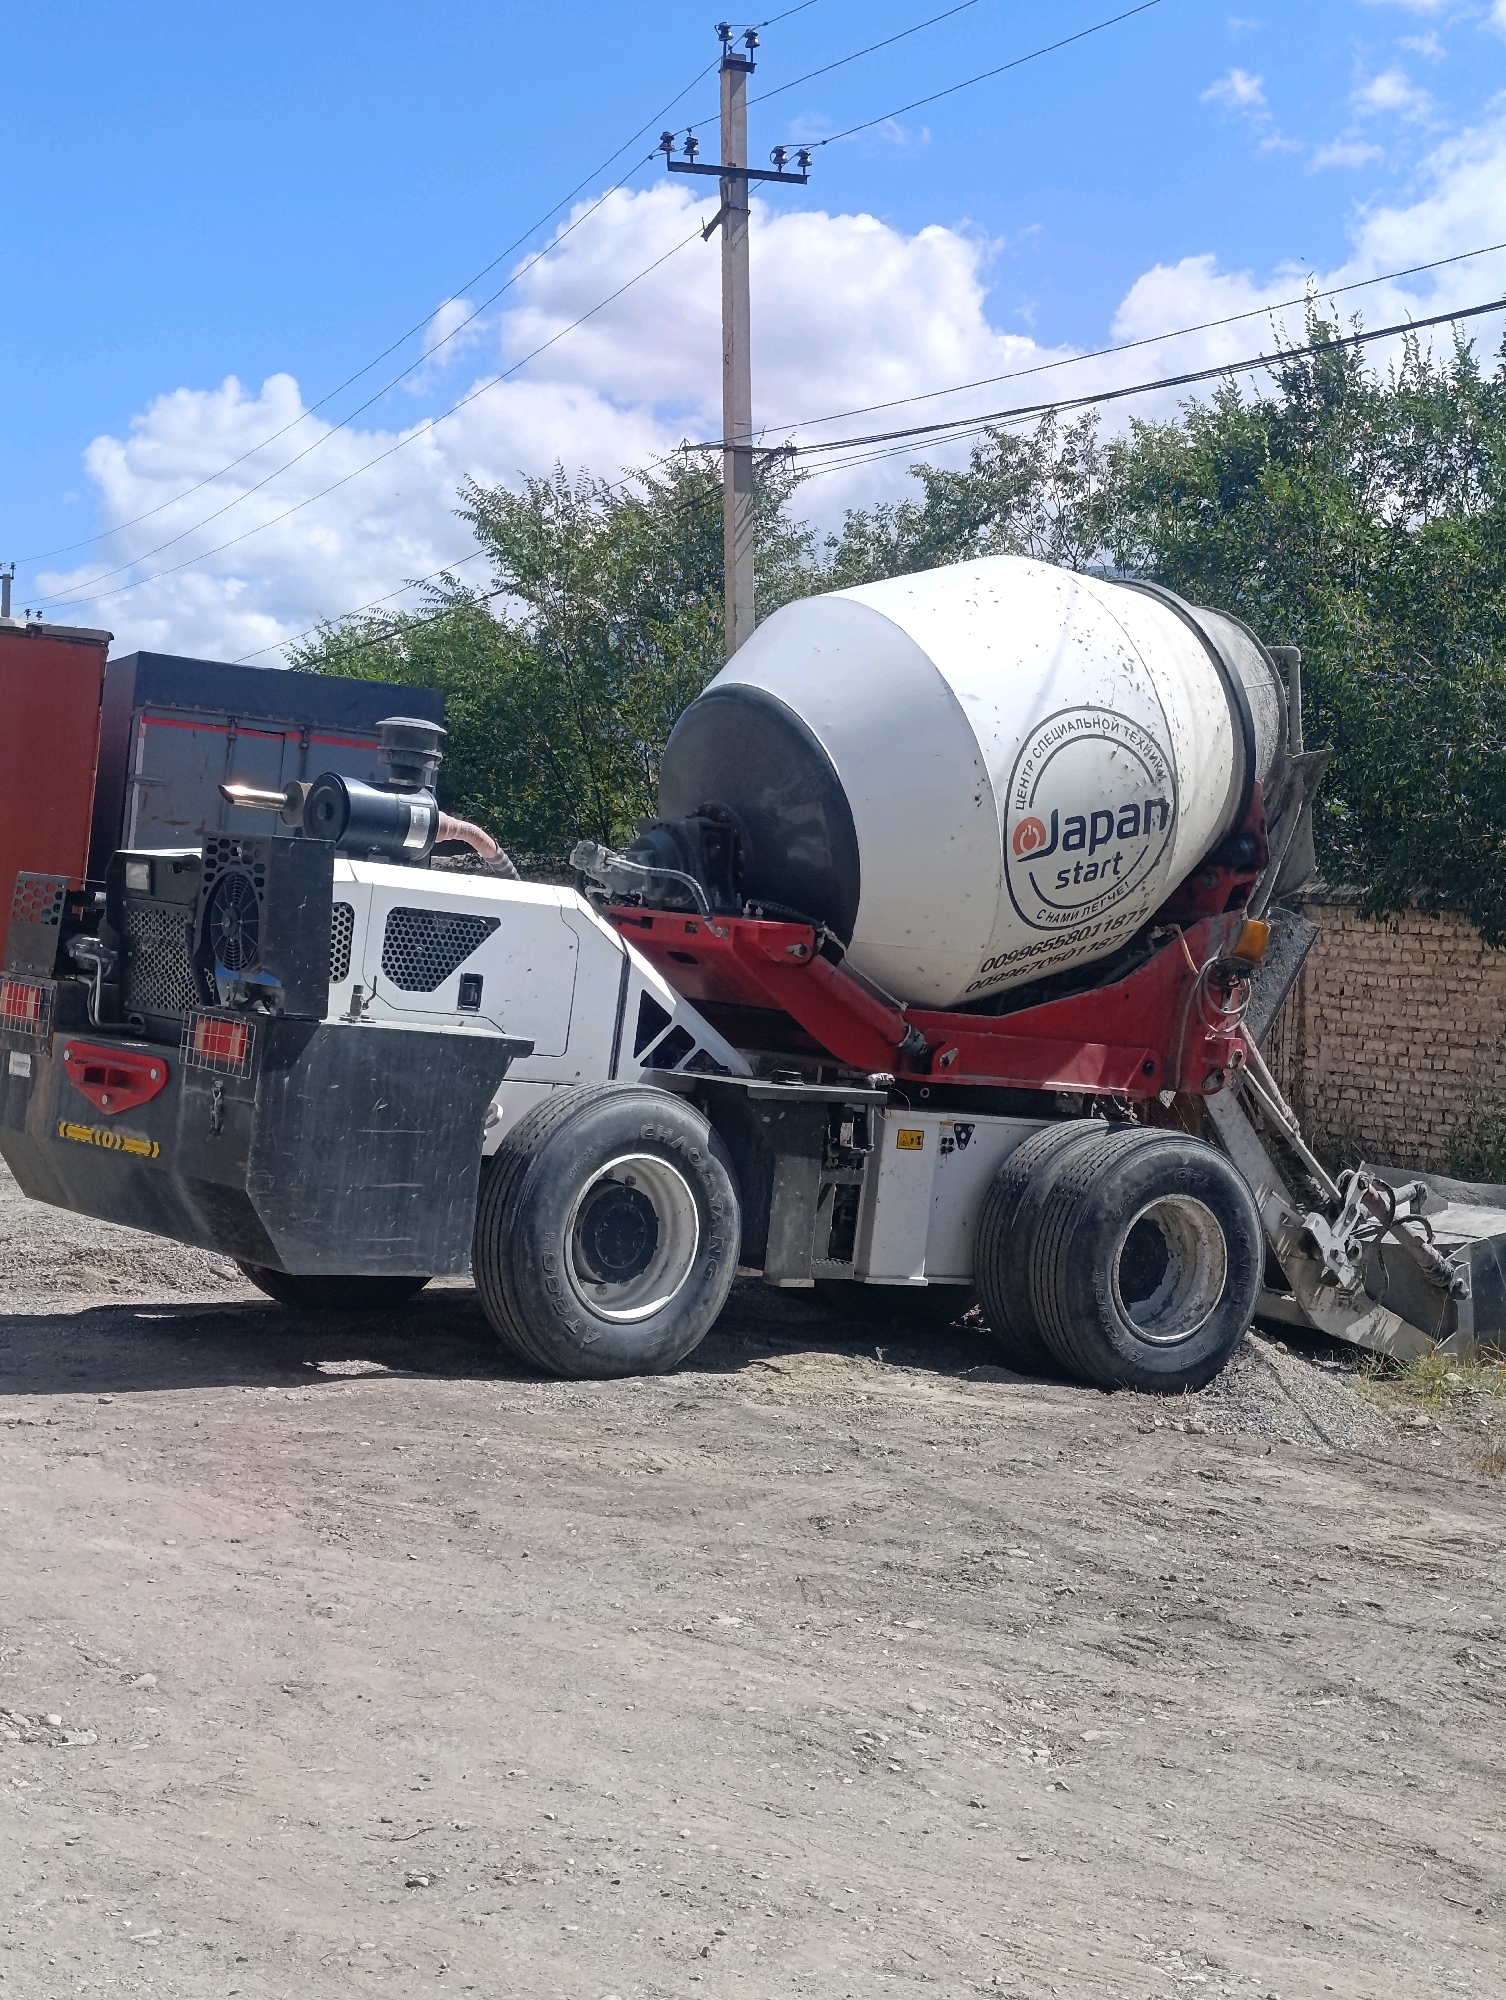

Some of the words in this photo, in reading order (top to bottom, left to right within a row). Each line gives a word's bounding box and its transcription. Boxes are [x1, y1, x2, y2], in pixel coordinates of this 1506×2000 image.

[1015, 759, 1035, 810] ЦЕНТР
[1032, 717, 1120, 759] СПЕЦИАЛЬНОЙ
[1017, 797, 1170, 862] Japan
[1055, 851, 1123, 889] start
[980, 906, 1149, 974] 00996558011877
[1045, 910, 1079, 924] НАМИ
[965, 929, 1134, 993] 00996705011877
